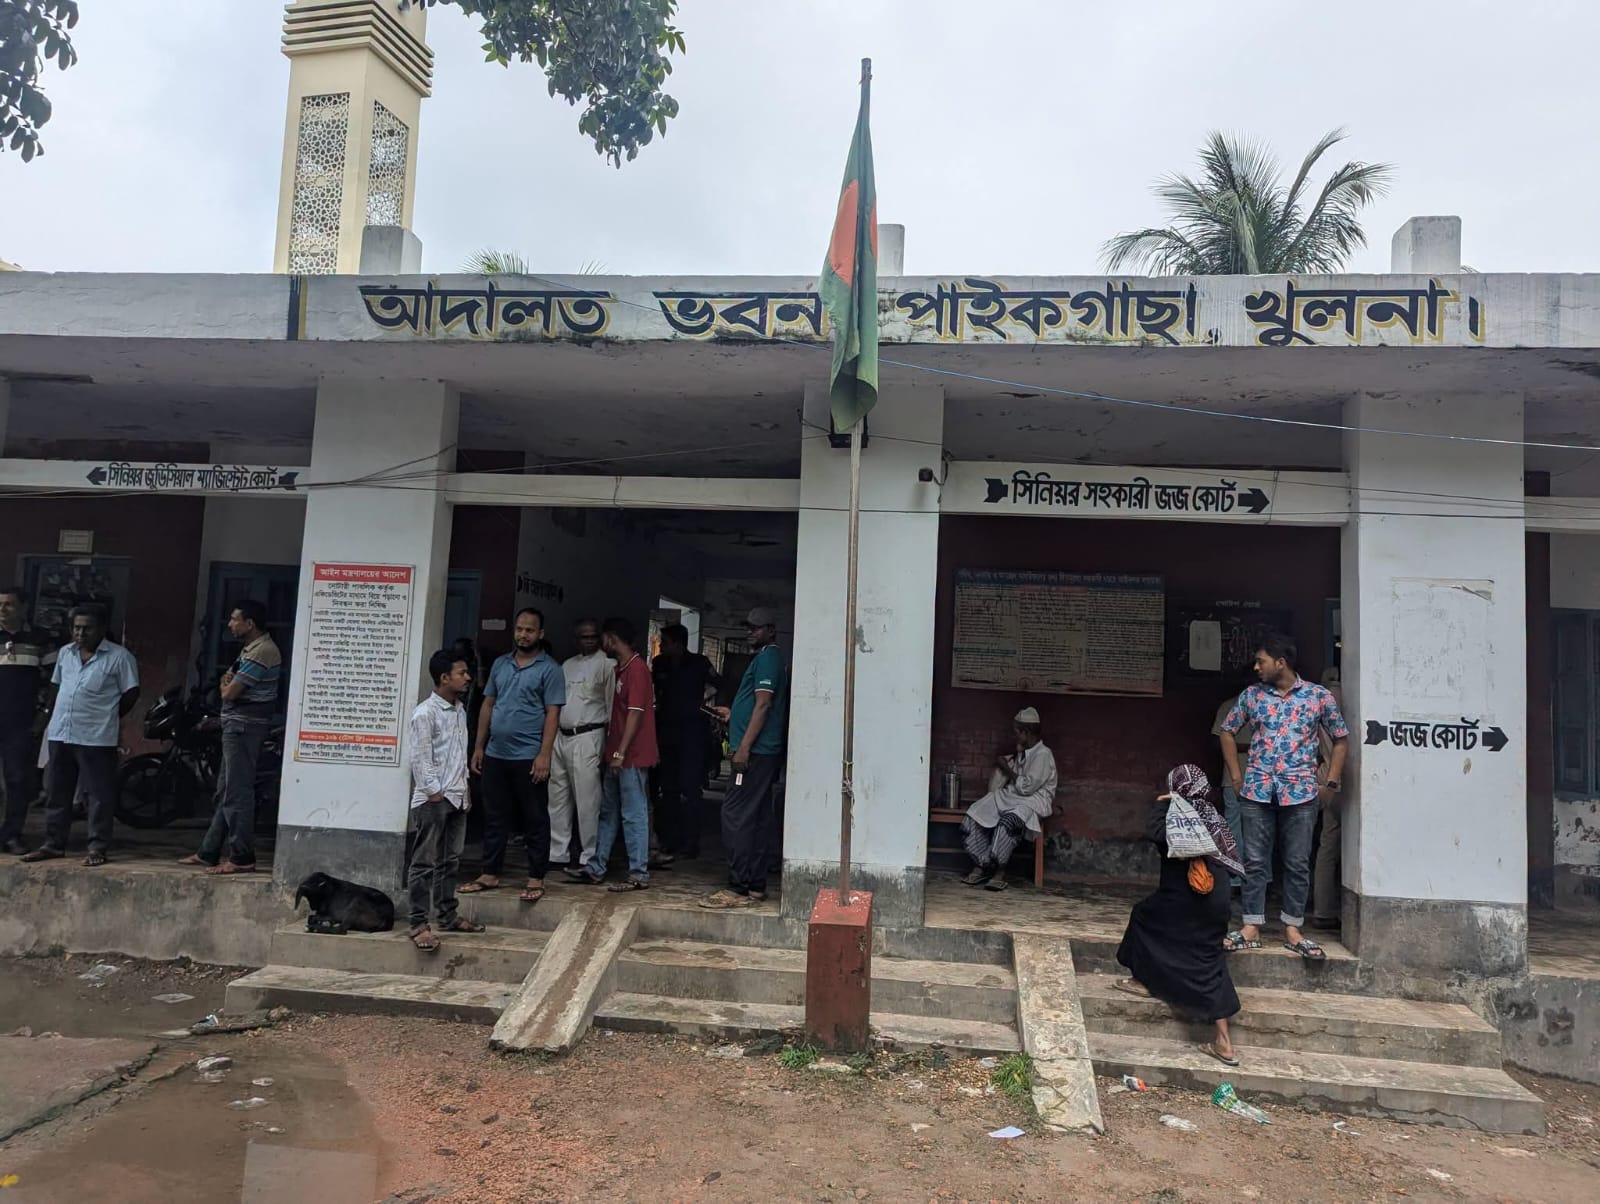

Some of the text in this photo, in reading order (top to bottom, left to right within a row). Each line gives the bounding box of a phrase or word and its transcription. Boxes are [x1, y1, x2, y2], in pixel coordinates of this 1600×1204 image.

[358, 280, 616, 341] আদালত
[653, 290, 828, 341] ভবন
[108, 462, 143, 486] সিনিয়র
[250, 466, 278, 489] কোর্ট
[1011, 470, 1238, 513] সিনিয়র সহকারী জজ কোর্ট
[1389, 716, 1480, 750] জজ কোর্ট
